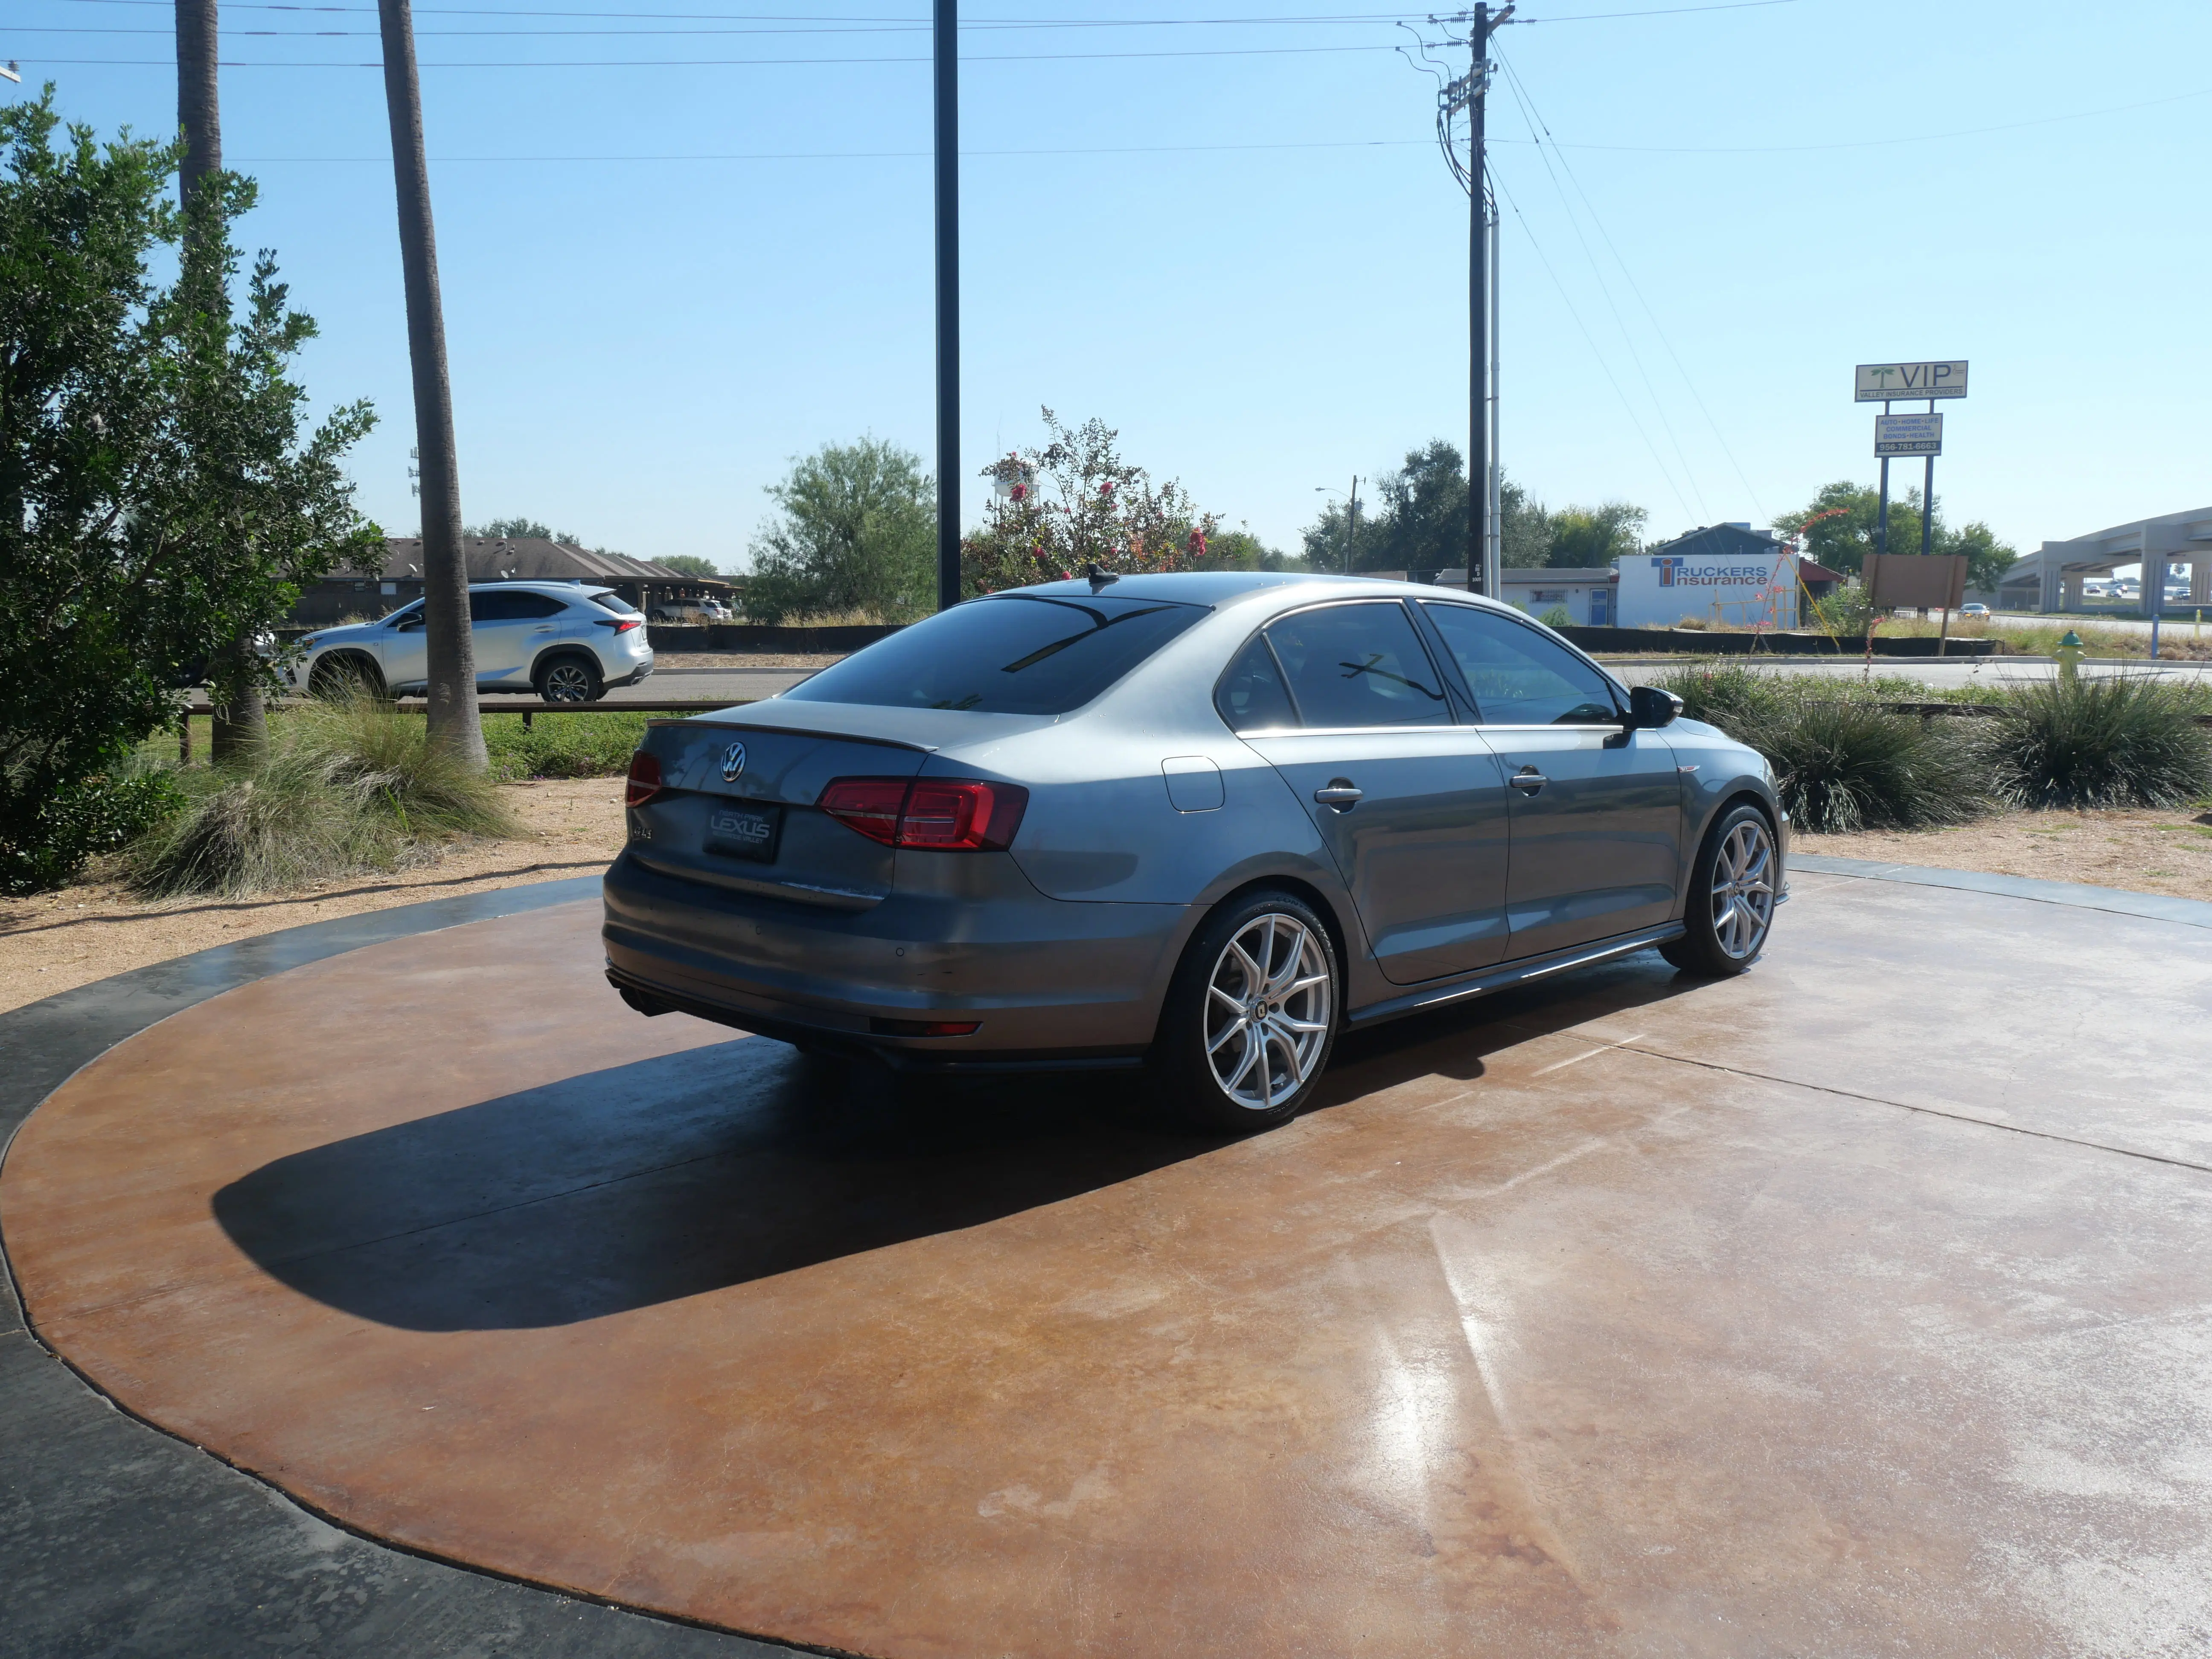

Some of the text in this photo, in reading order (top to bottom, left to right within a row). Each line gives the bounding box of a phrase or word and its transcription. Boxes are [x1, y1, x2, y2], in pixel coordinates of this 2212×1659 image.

[1900, 364, 1951, 388] VIP
[1880, 442, 1937, 451] 956-781-6663
[1651, 557, 1767, 587] TRUCKERS
[710, 815, 770, 838] LEXUS
